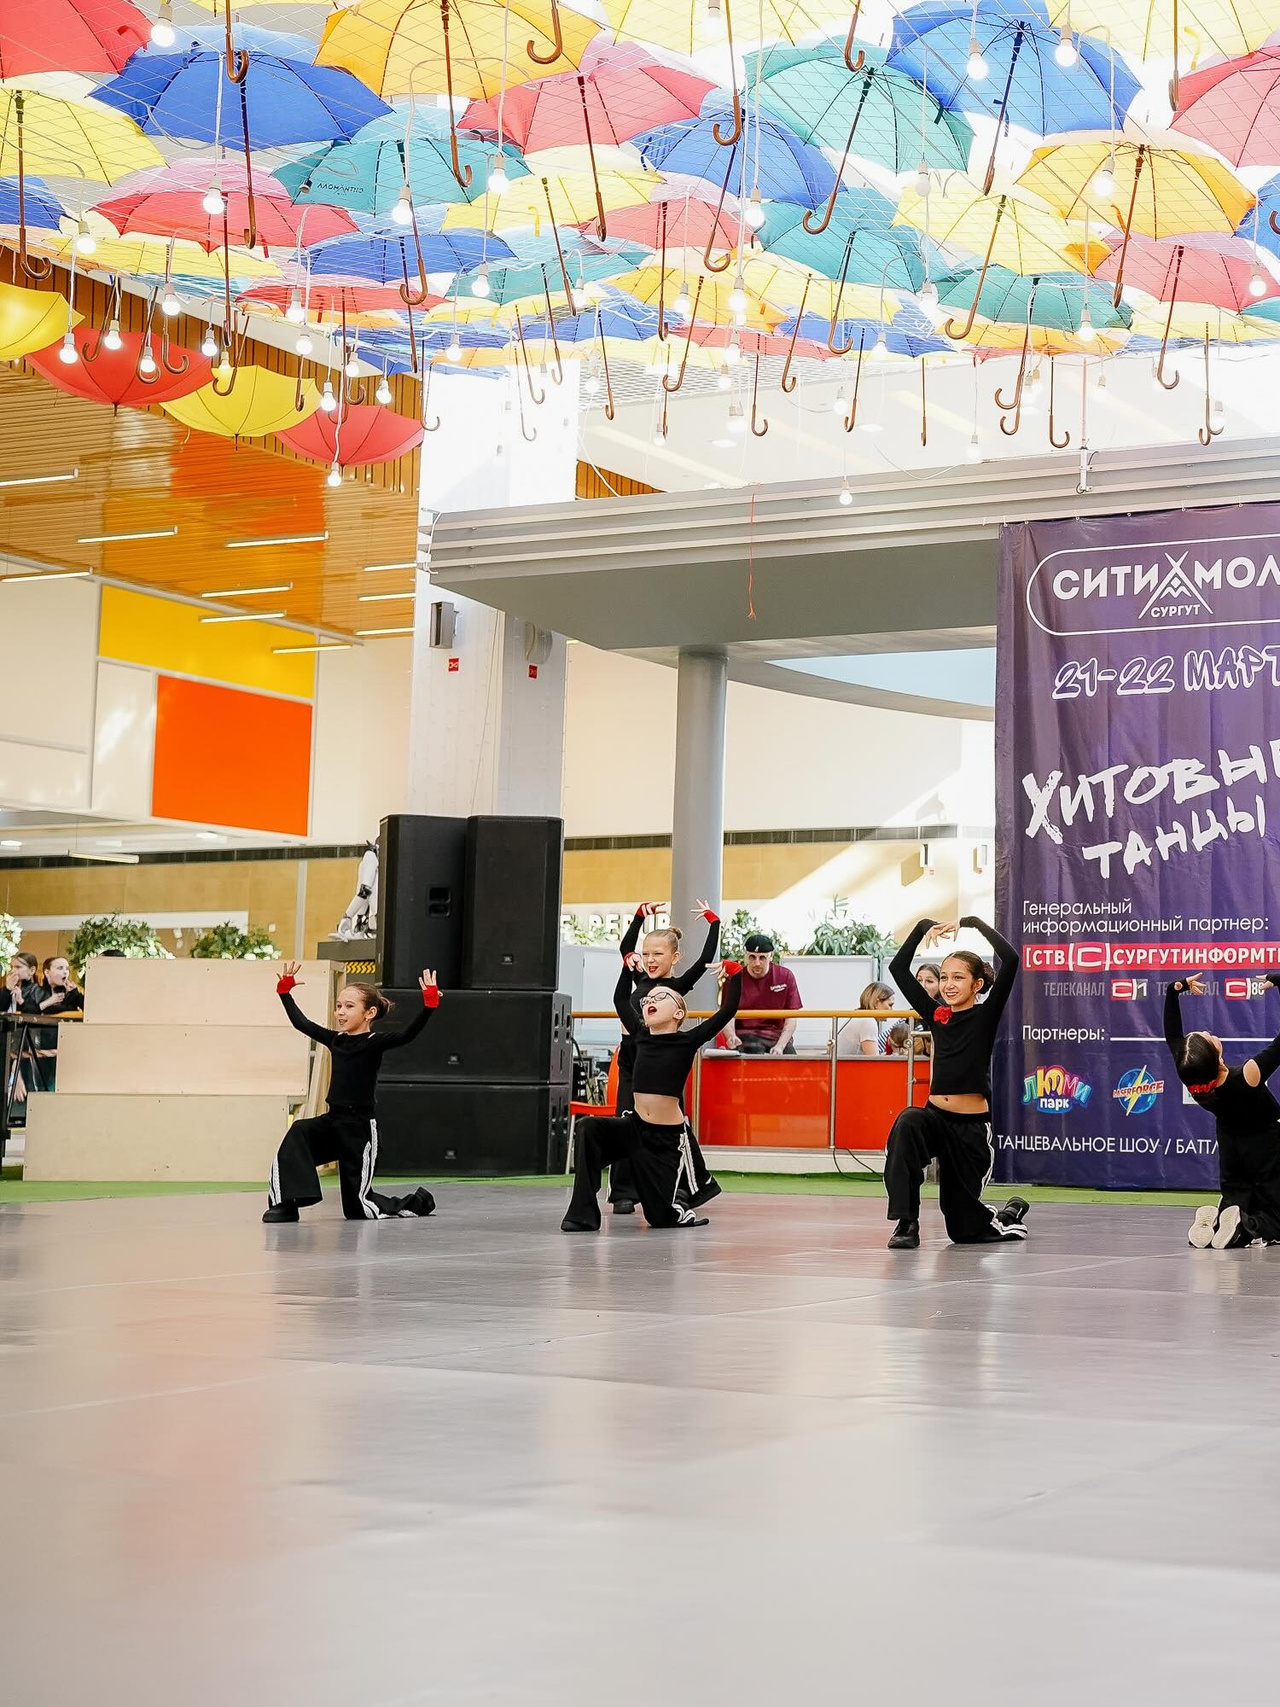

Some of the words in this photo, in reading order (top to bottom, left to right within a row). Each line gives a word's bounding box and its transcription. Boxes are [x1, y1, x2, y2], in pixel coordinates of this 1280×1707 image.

[1052, 563, 1158, 600] СИТИ
[1150, 604, 1201, 618] СУРГУТ
[1052, 656, 1175, 700] 21-22
[1083, 795, 1267, 879] ТАНЦЫ
[1022, 898, 1132, 917] Генеральный
[1022, 916, 1183, 936] информационный
[1188, 916, 1269, 935] партнер:
[1043, 981, 1105, 997] ТЕЛЕКАНАЛ
[1022, 1025, 1105, 1044] Партнеры:
[1039, 1098, 1070, 1111] парк
[997, 1134, 1115, 1152] ТАНЦЕВАЛЬНОЕ
[1119, 1137, 1160, 1154] ШОУ
[1176, 1138, 1218, 1155] БАТТЛ
